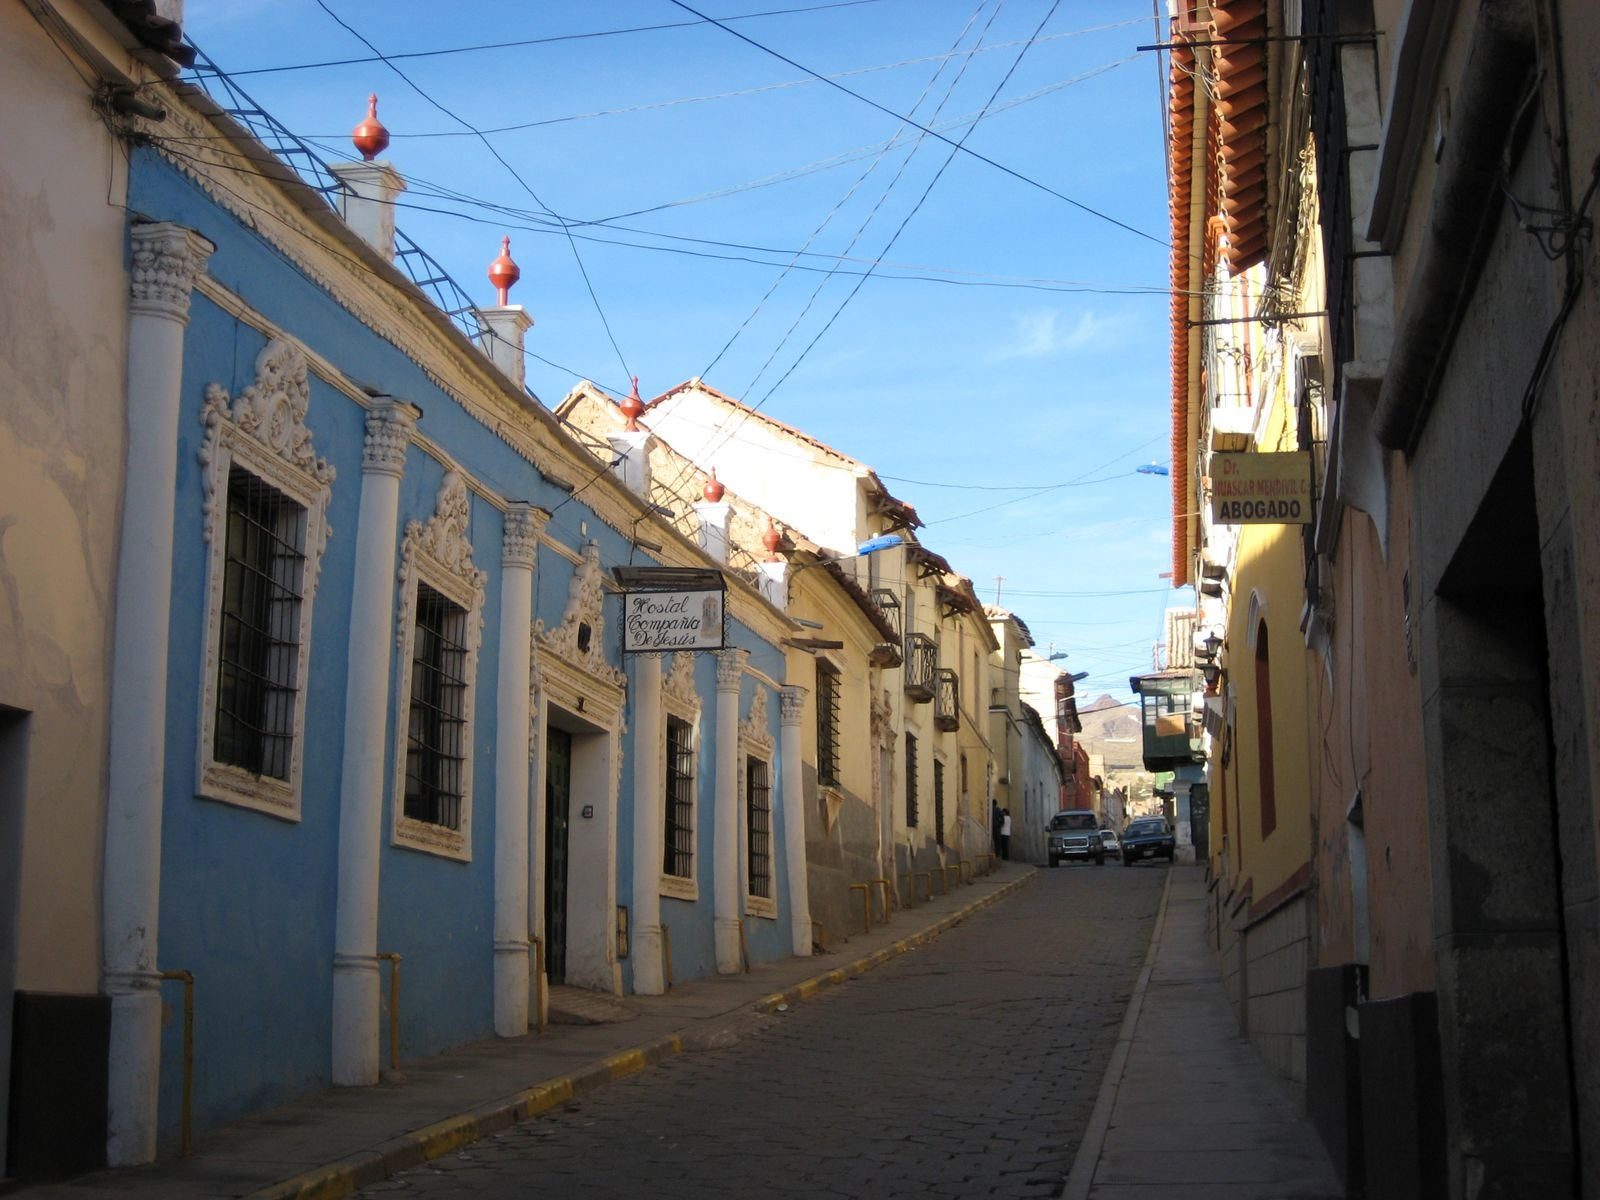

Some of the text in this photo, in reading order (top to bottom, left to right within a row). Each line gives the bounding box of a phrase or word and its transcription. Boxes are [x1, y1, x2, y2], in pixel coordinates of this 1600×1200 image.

[1223, 459, 1240, 475] Dr.
[1220, 500, 1301, 519] ABOGADO
[633, 596, 690, 614] Hostal
[632, 630, 653, 647] De
